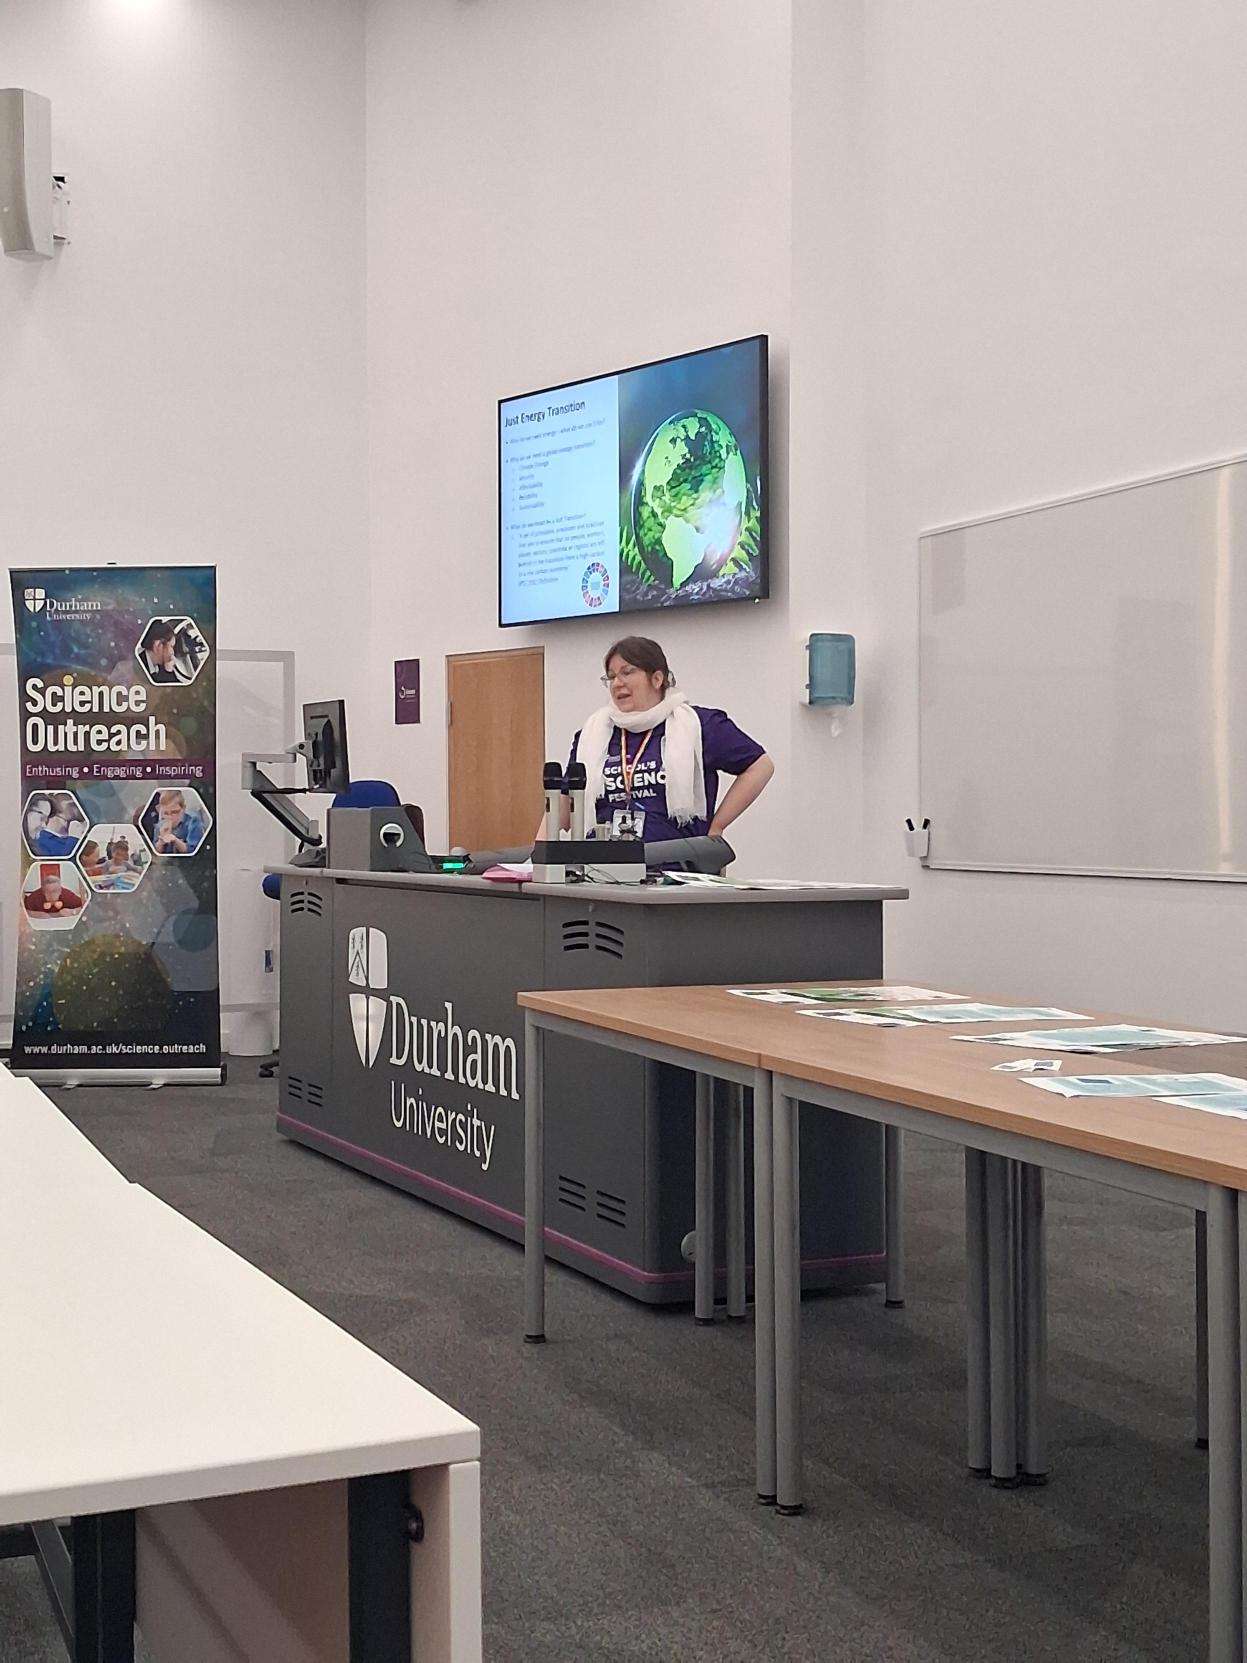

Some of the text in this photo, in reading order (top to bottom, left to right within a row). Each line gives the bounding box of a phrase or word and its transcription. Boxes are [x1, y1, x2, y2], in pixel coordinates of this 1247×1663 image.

[505, 401, 586, 427] Just Energy Transition
[46, 597, 101, 611] Durham
[46, 611, 91, 621] University
[25, 674, 147, 713] Science
[26, 715, 166, 752] Outreach
[26, 763, 203, 778] Enthusing Engaging Inspiring
[608, 788, 657, 803] FESIVAL
[24, 1042, 206, 1055] www.durham.ac.uk/science.outreach
[389, 995, 520, 1101] Durham
[391, 1080, 495, 1171] University
